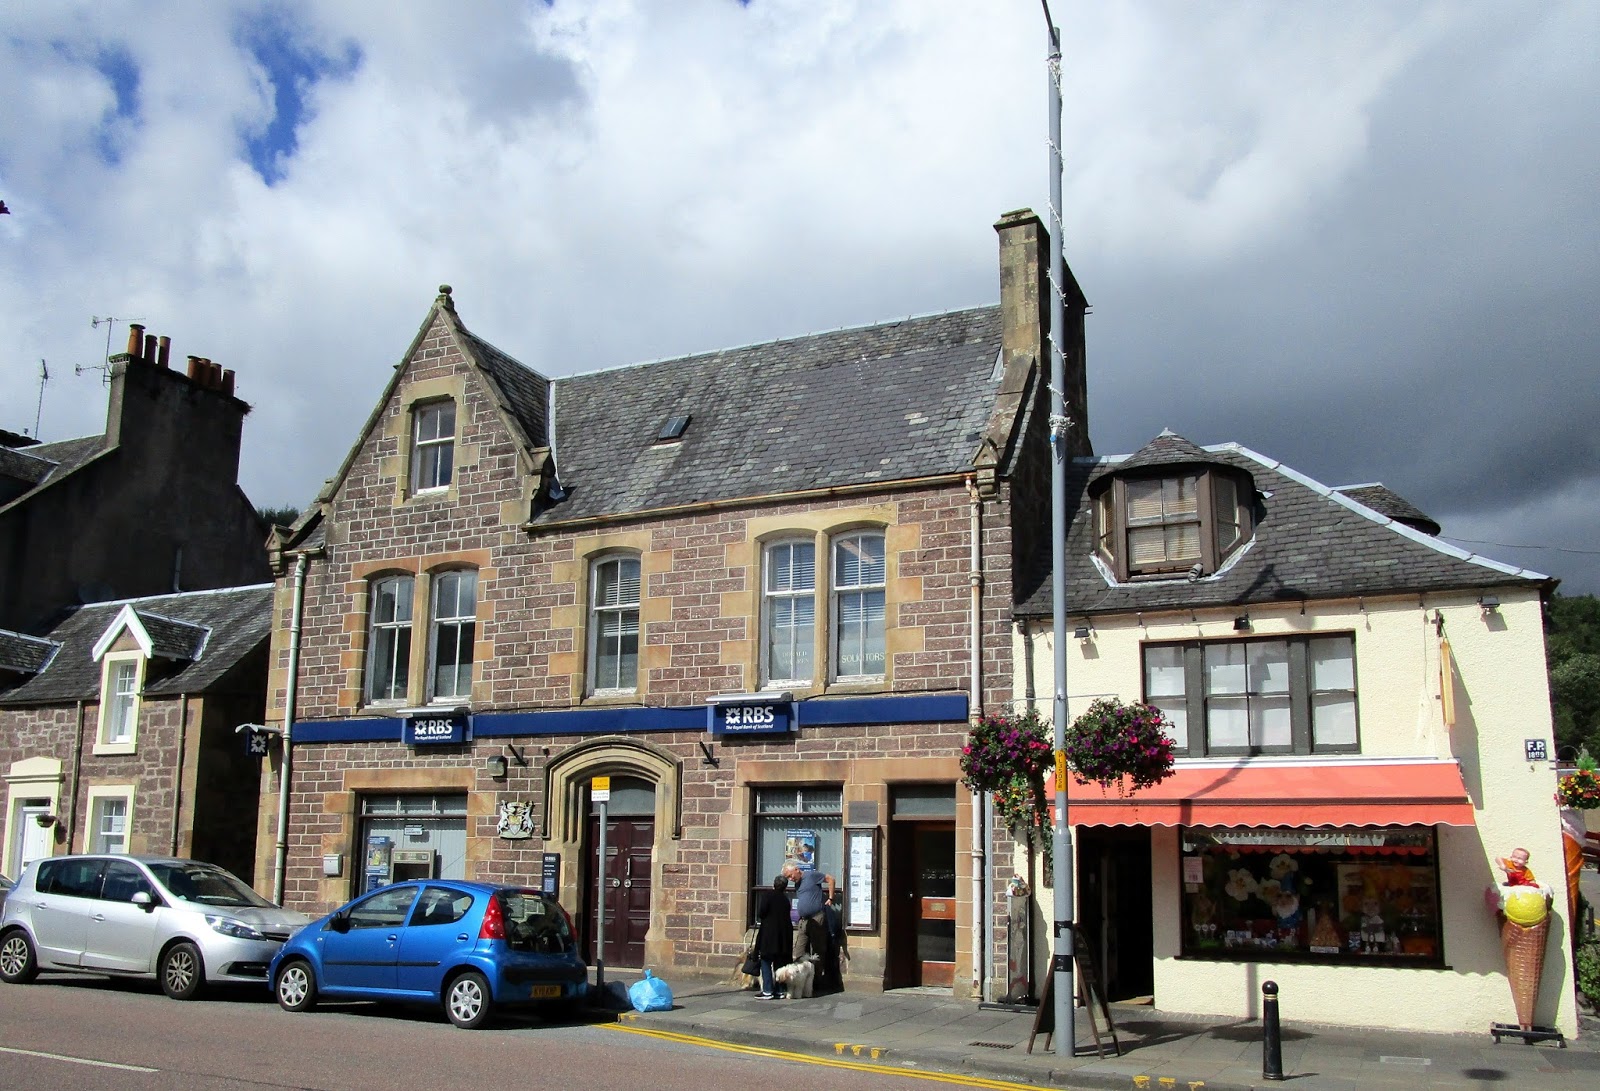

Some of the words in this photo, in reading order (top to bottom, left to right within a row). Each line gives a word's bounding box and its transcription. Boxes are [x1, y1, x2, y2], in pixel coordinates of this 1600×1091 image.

[841, 652, 885, 664] SOLICTORS
[742, 706, 774, 723] RBS
[428, 719, 453, 735] RBS
[1527, 741, 1545, 751] F.P.
